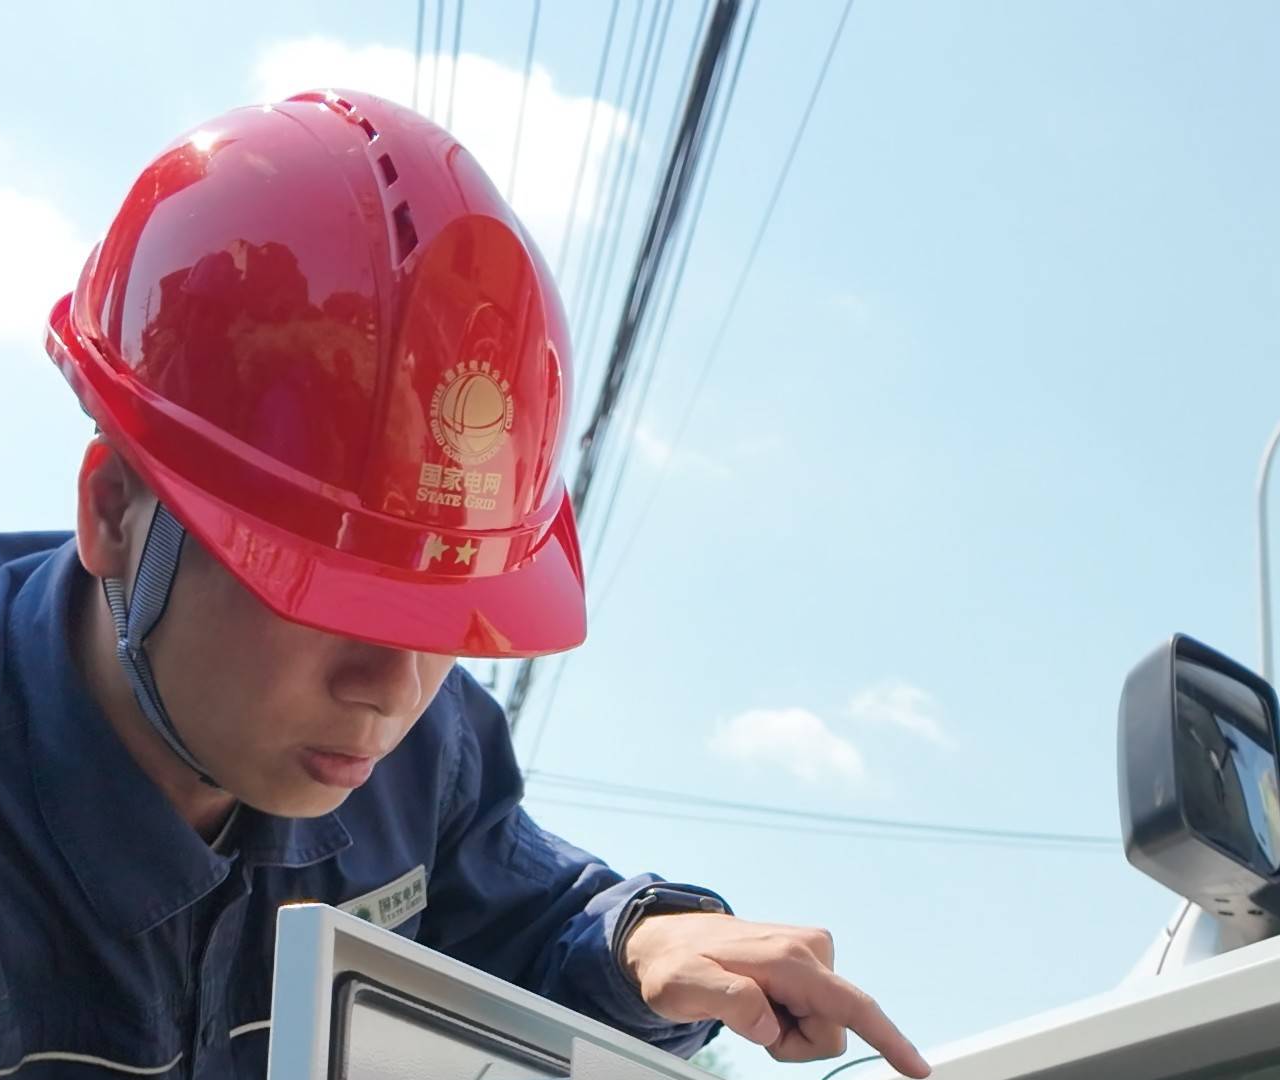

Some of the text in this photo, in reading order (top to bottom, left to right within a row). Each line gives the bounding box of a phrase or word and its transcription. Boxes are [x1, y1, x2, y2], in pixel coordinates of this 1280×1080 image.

[419, 463, 502, 495] 国家电网
[416, 487, 496, 510] STATE GRID
